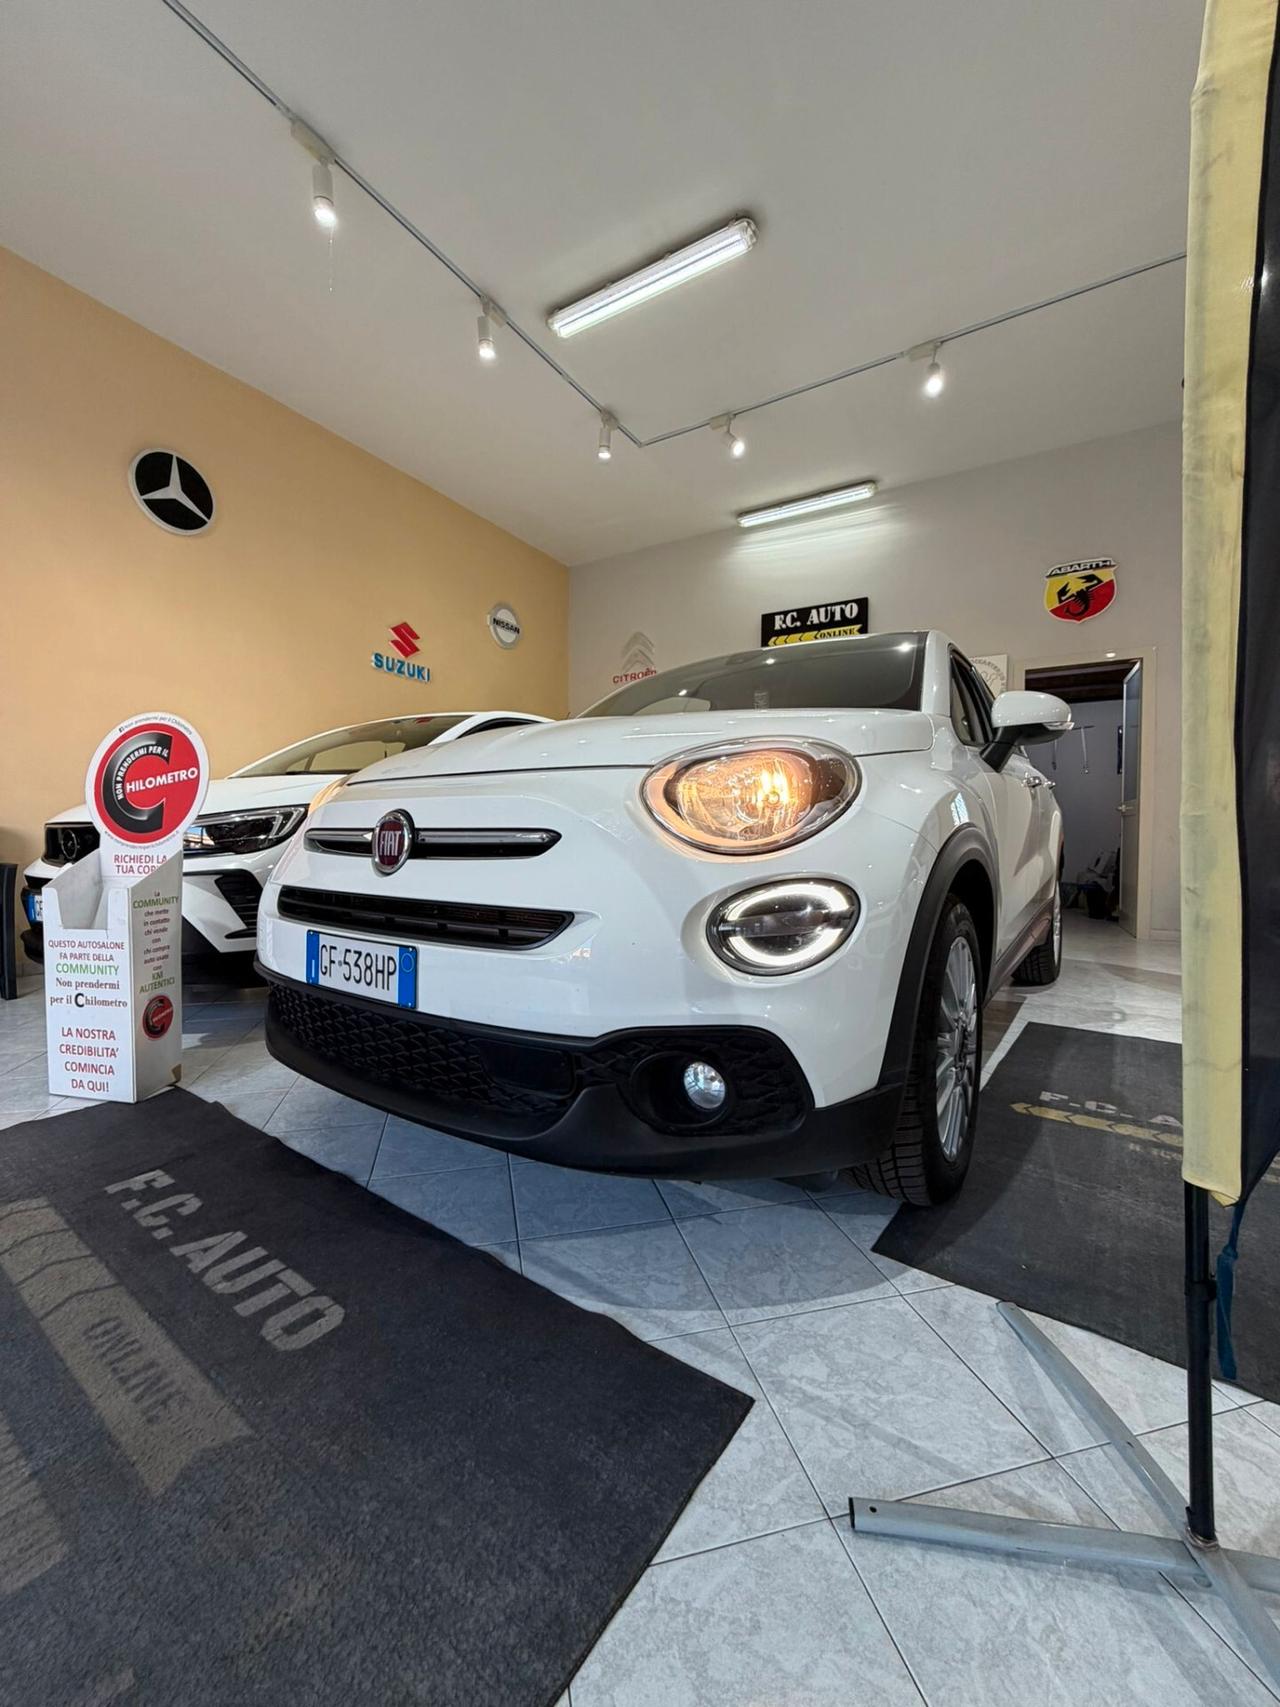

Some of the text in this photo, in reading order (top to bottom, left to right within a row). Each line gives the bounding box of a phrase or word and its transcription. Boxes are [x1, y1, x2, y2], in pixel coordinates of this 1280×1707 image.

[1051, 560, 1110, 575] ABARTH
[774, 602, 859, 630] F.C. AUTO
[493, 617, 520, 635] NISSAN
[819, 627, 856, 639] ONLINE
[372, 652, 431, 682] SUZUKI
[148, 745, 162, 754] PER
[116, 747, 147, 782] PRENDERMI
[116, 782, 124, 800] NON
[379, 830, 401, 856] FIAT
[114, 854, 167, 864] RICHIEDI LA
[116, 865, 159, 874] TUA COP
[133, 896, 179, 909] COMMUNITY
[48, 940, 125, 950] QUESTO AUTOSALONE
[59, 952, 114, 961] FA PARTE DELLA
[55, 963, 119, 976] COMMUNITY
[55, 977, 120, 990] Non prendermi
[139, 977, 175, 994] AUTENTICI
[50, 992, 128, 1008] per il Chilometro
[61, 1027, 116, 1041] LA NOSTRA
[59, 1043, 119, 1058] CREDIBILITA'
[64, 1061, 115, 1075] COMINCIA
[71, 1079, 109, 1092] DA QUI!
[1039, 1090, 1134, 1119] F.C.
[104, 1168, 345, 1352] F.C. AUTO
[82, 1316, 184, 1426] ONLINE
